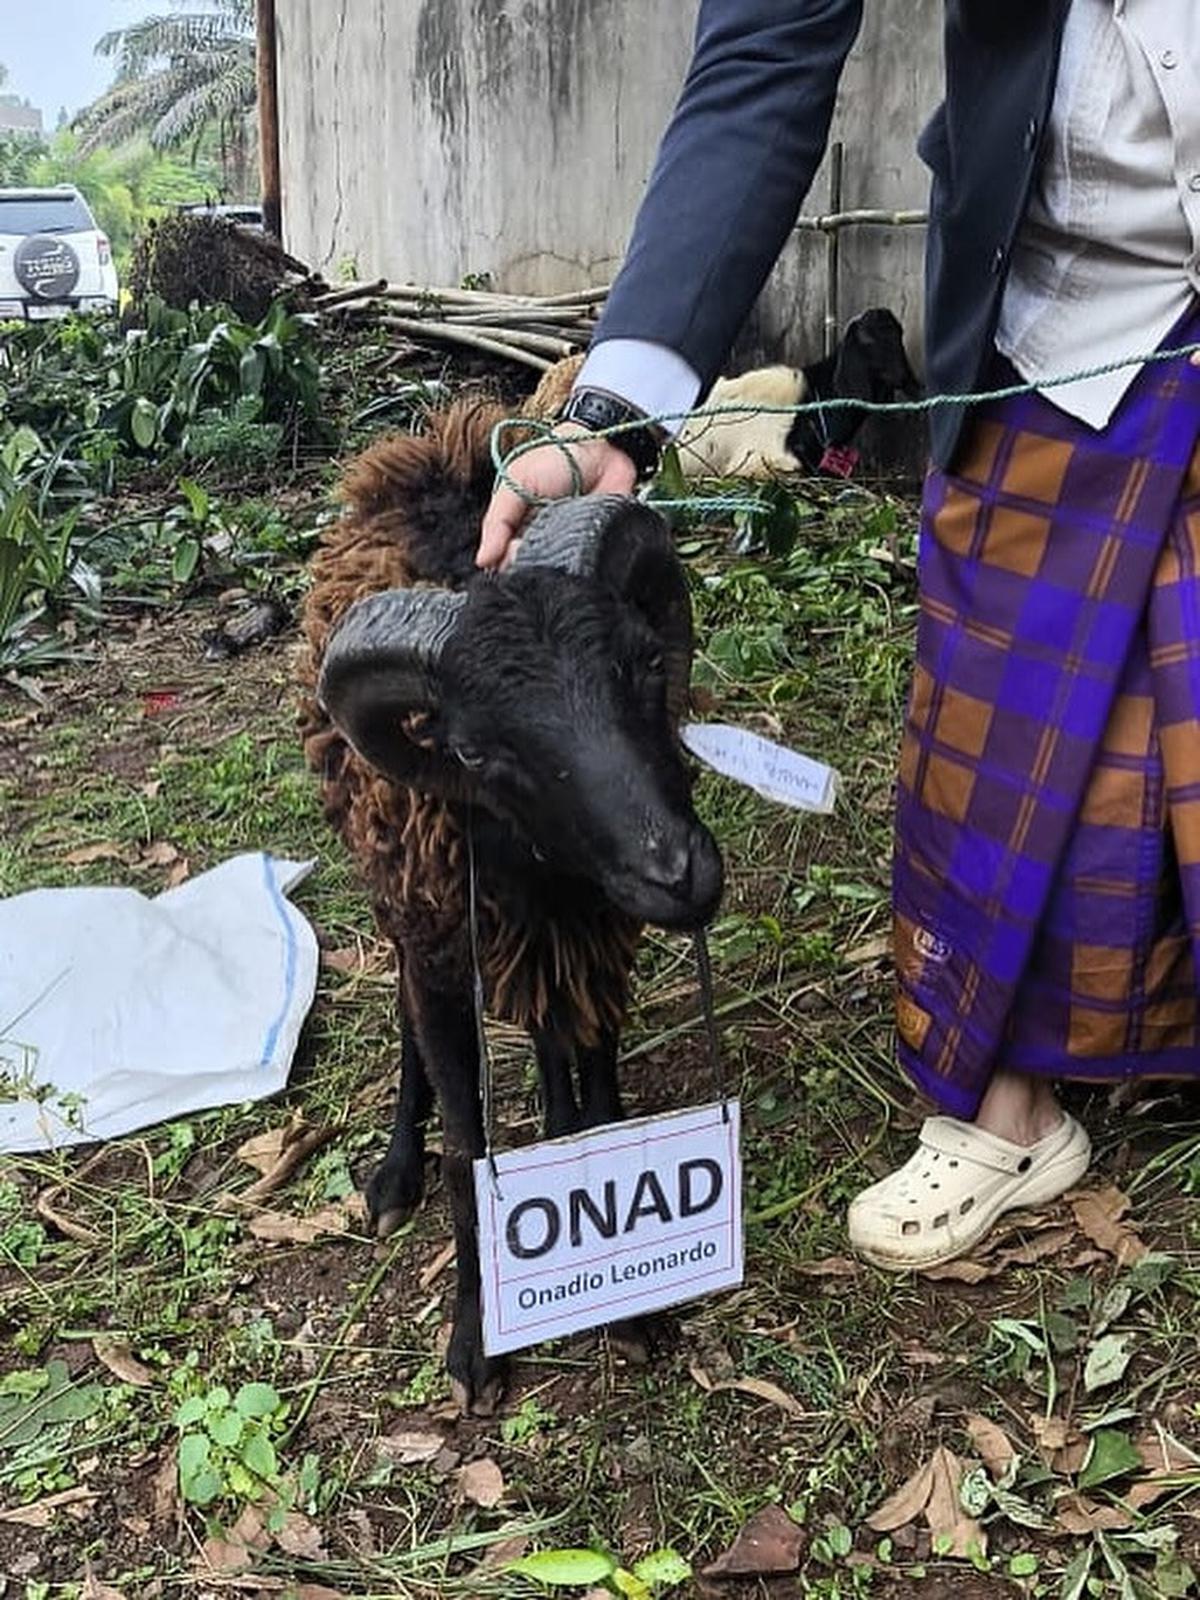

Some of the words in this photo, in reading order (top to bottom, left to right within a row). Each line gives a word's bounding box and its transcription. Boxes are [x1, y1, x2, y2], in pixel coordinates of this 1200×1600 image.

[505, 1157, 724, 1260] ONAD
[518, 1272, 604, 1310] Onadio
[611, 1240, 717, 1284] Leonardo
